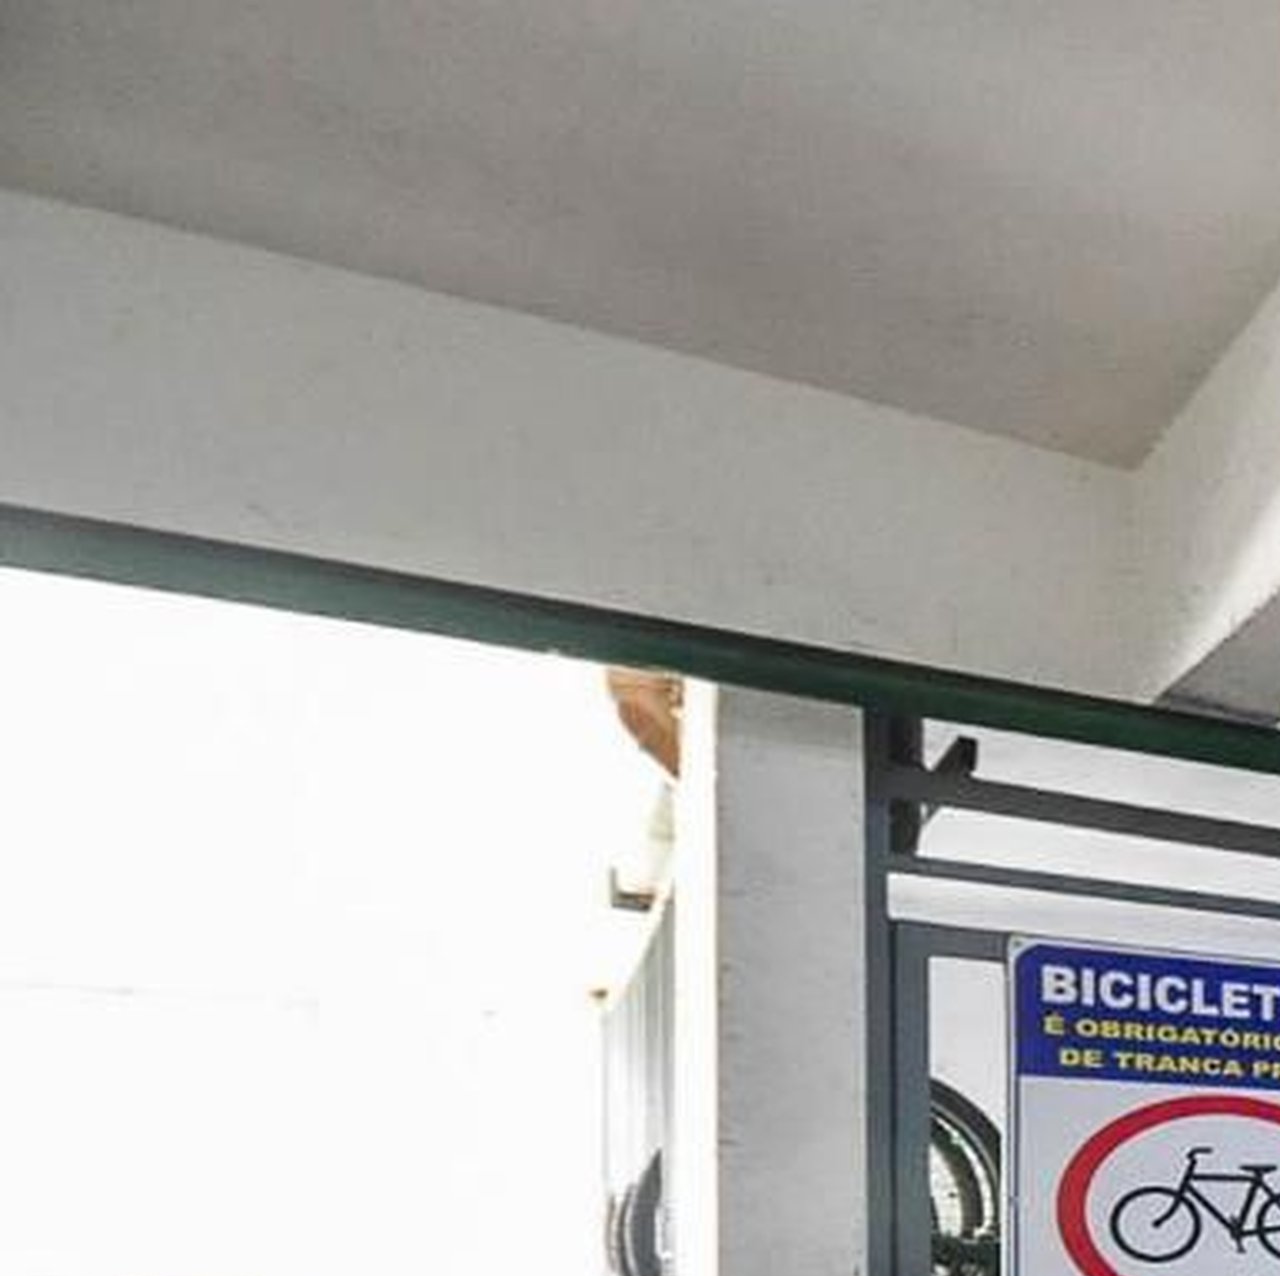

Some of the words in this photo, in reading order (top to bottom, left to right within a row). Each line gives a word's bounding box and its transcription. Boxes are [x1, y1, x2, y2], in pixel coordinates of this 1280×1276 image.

[1043, 1010, 1065, 1036] É
[1059, 1047, 1103, 1068] DE
[1114, 1051, 1244, 1077] TRANCA
